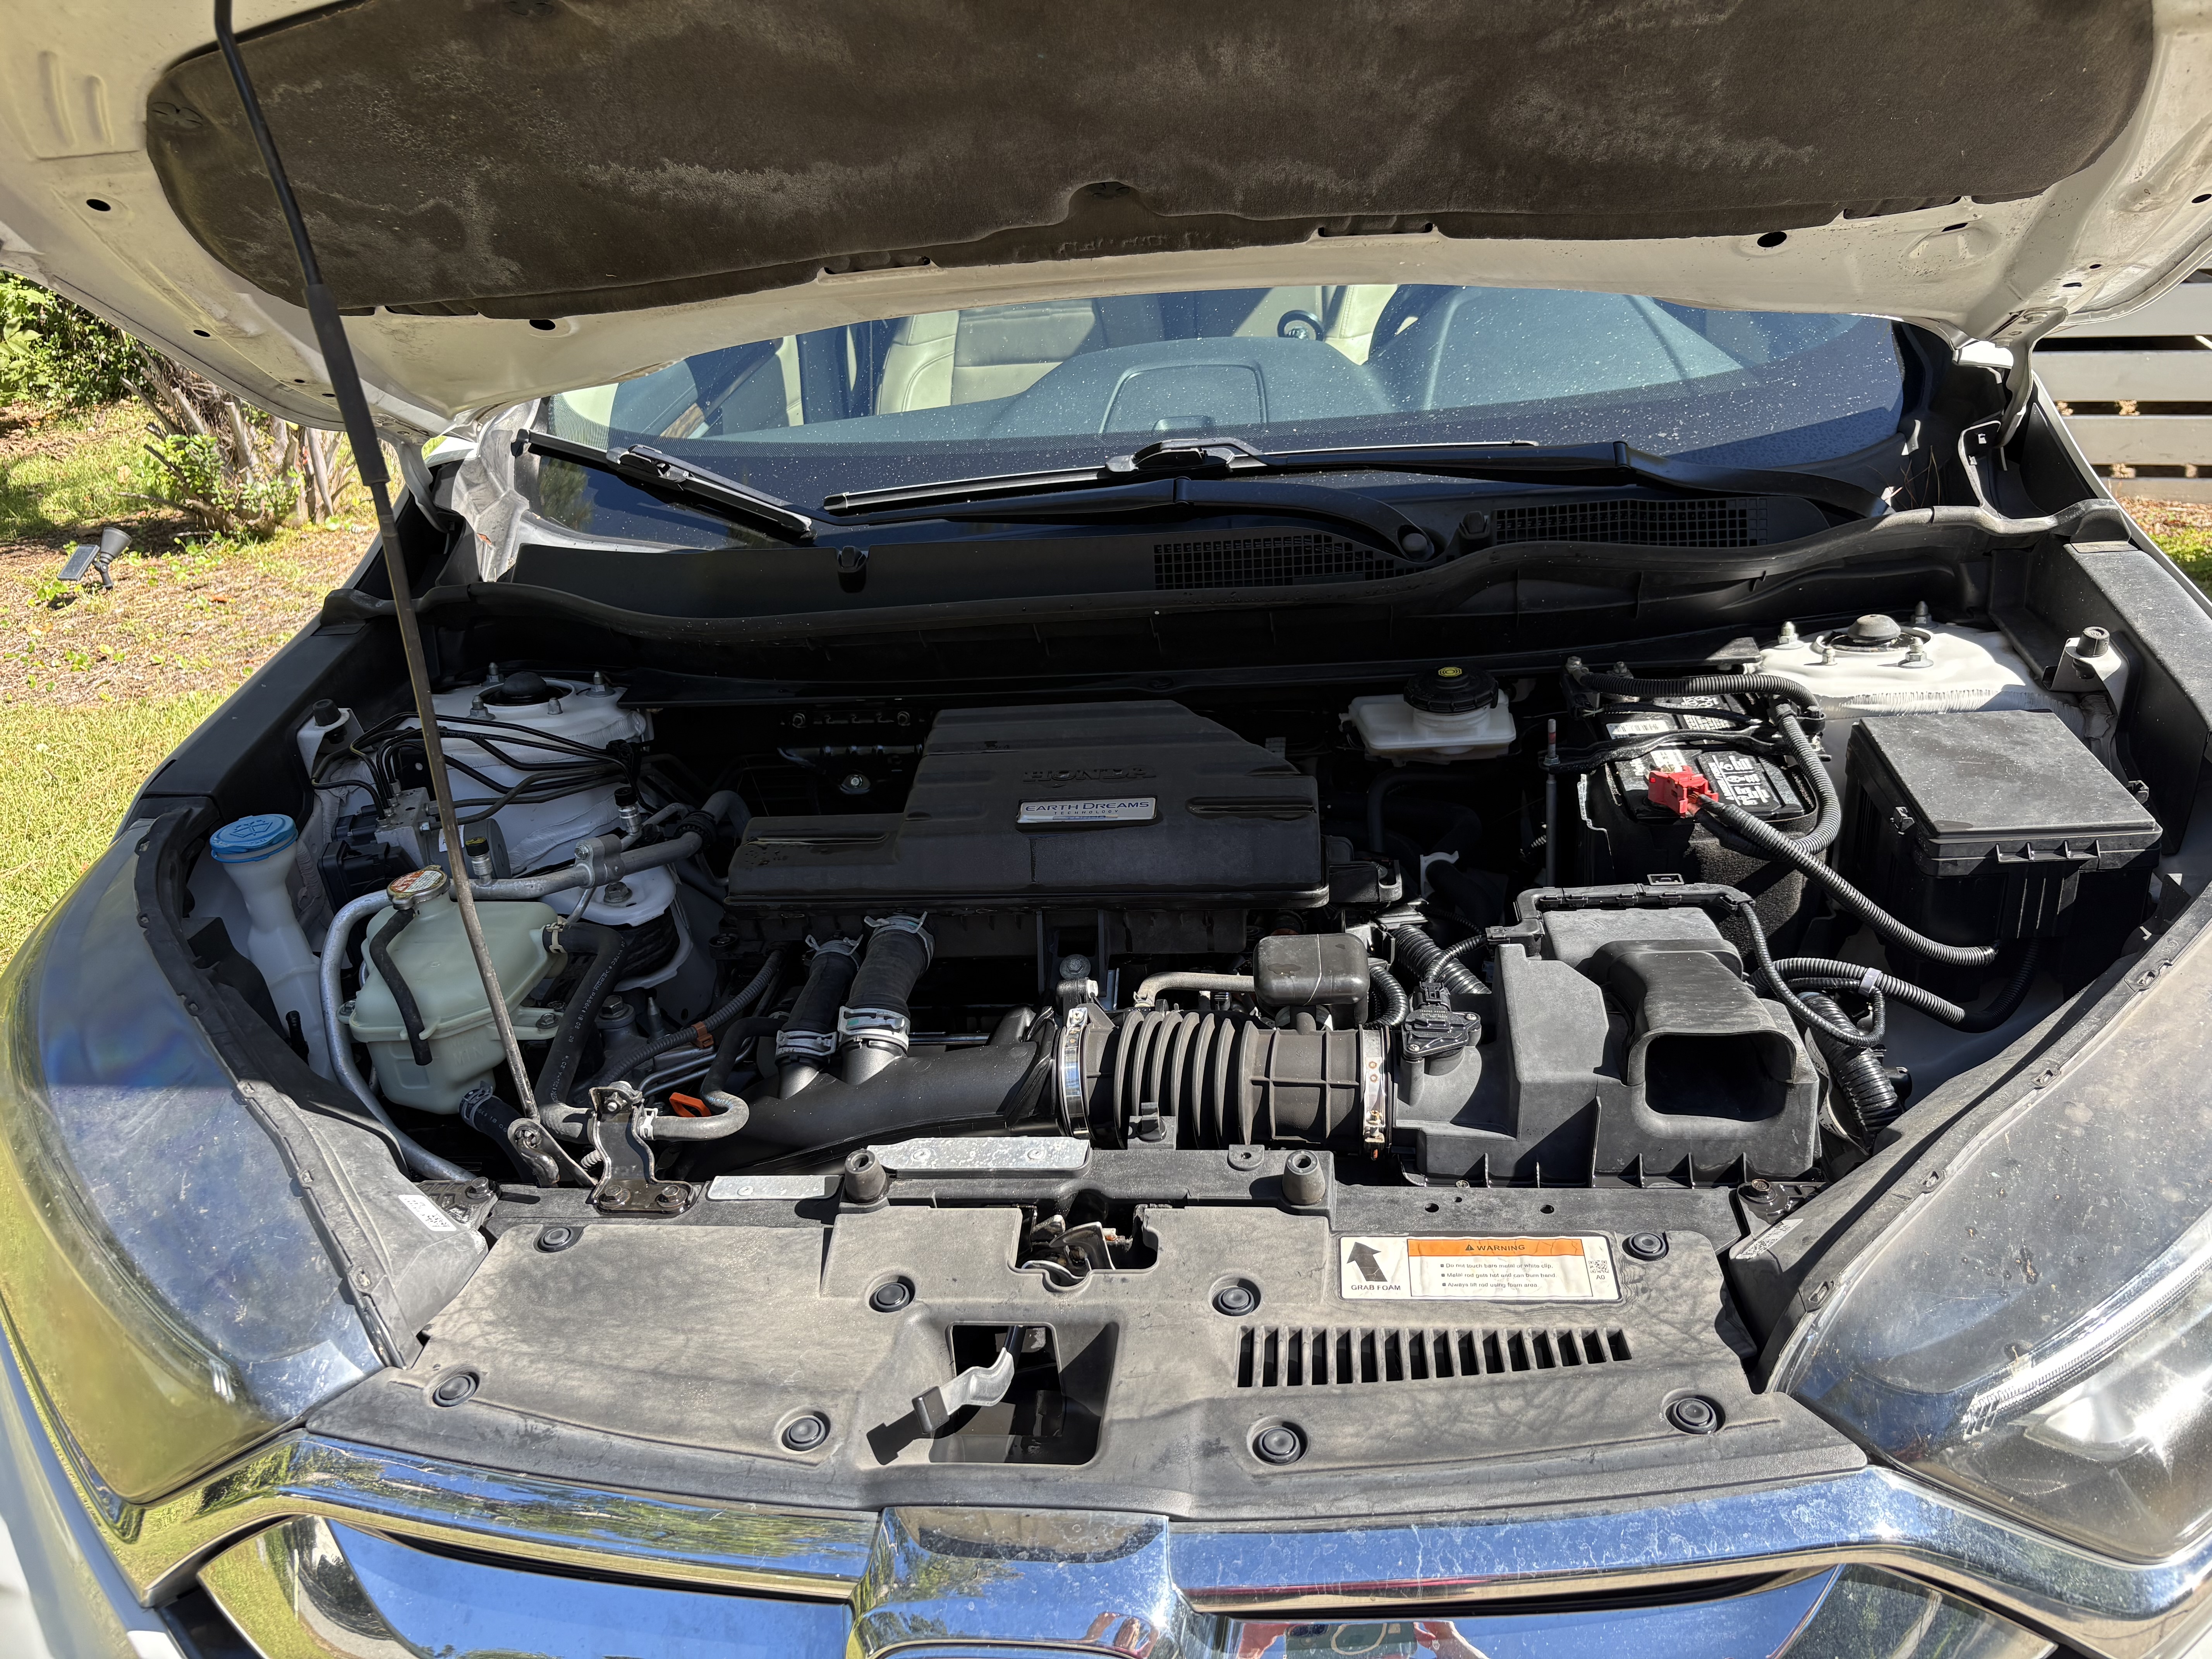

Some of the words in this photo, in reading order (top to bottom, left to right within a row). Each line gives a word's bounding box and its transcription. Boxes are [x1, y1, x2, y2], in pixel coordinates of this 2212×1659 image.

[1022, 768, 1156, 782] HONDA
[1083, 802, 1149, 810] DREAMS
[453, 1044, 484, 1066] MIN
